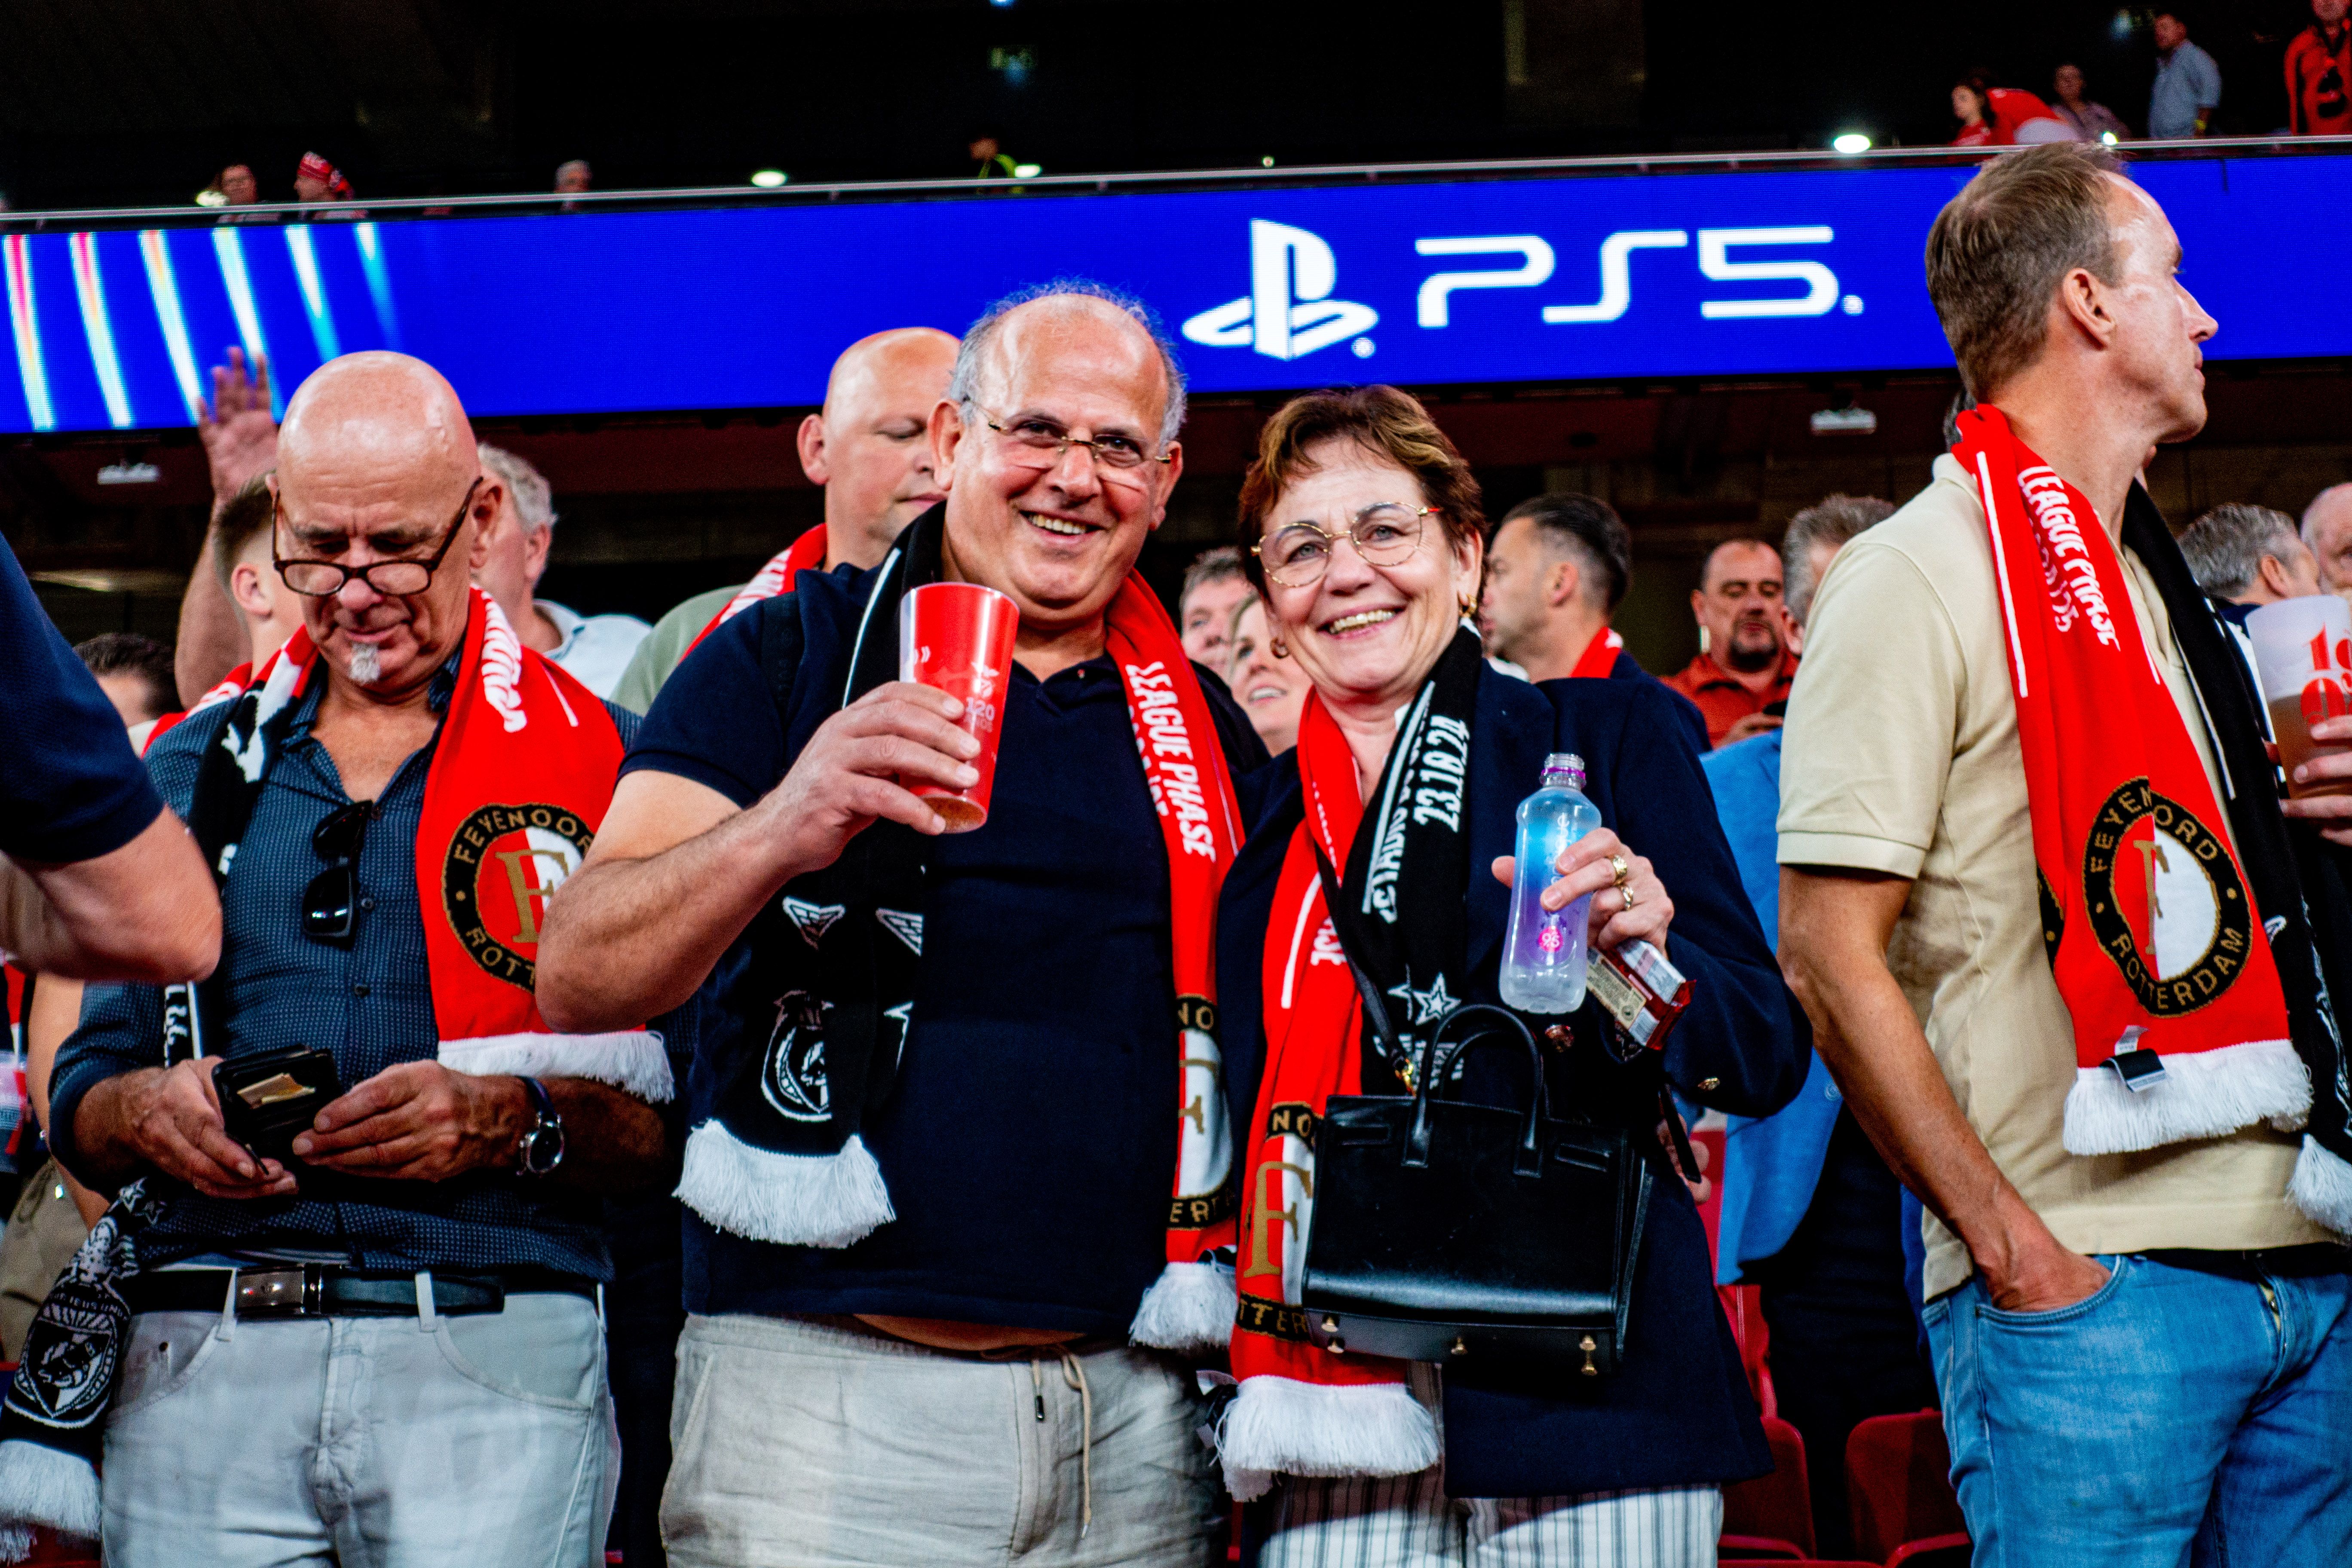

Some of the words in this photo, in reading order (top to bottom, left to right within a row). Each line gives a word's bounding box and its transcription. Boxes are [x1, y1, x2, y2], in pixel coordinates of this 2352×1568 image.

[1414, 225, 1840, 328] PS5
[2017, 465, 2090, 558] LEAGUE
[2064, 558, 2121, 652] PHASE
[1125, 661, 1194, 761] LEAGUE
[453, 808, 594, 865] FEYENOOR
[1159, 761, 1216, 863] PHASE
